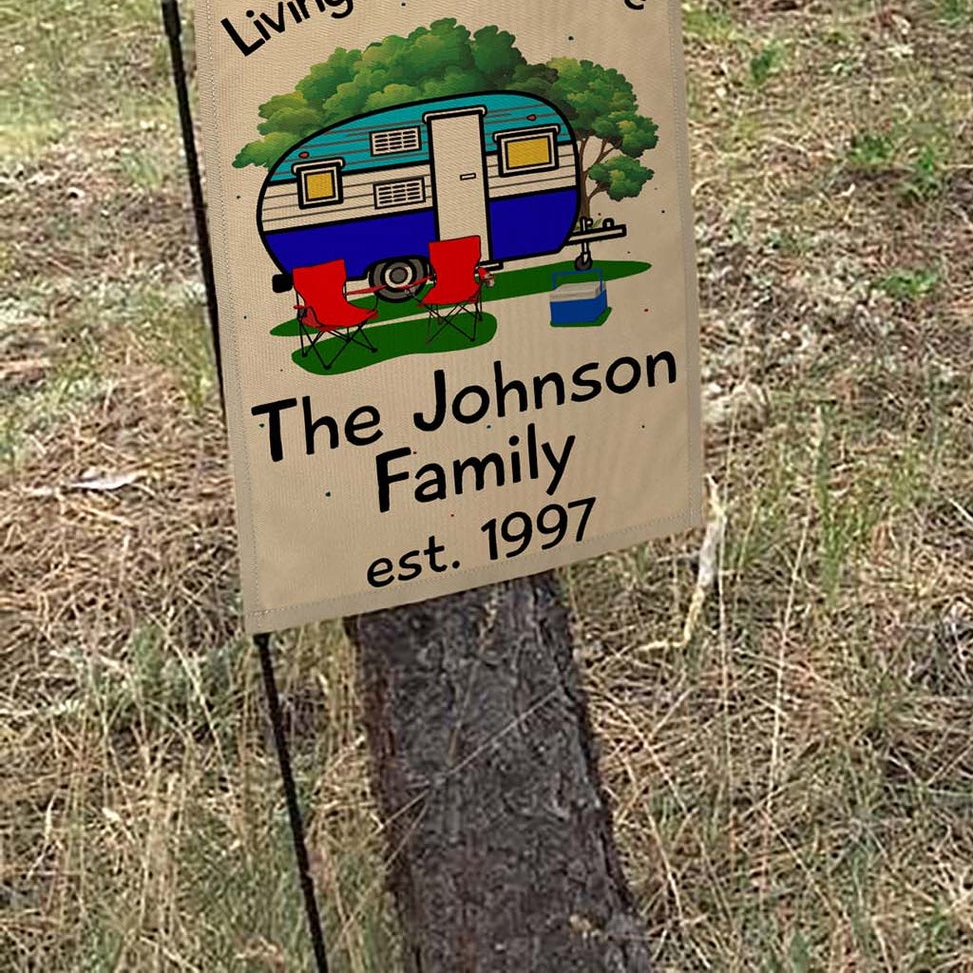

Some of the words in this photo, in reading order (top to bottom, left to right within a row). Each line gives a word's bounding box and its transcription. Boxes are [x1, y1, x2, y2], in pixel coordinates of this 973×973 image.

[251, 395, 384, 462] The
[413, 350, 677, 432] Johnson
[375, 423, 576, 513] Family
[366, 535, 461, 588] est.
[480, 496, 597, 561] 1997
